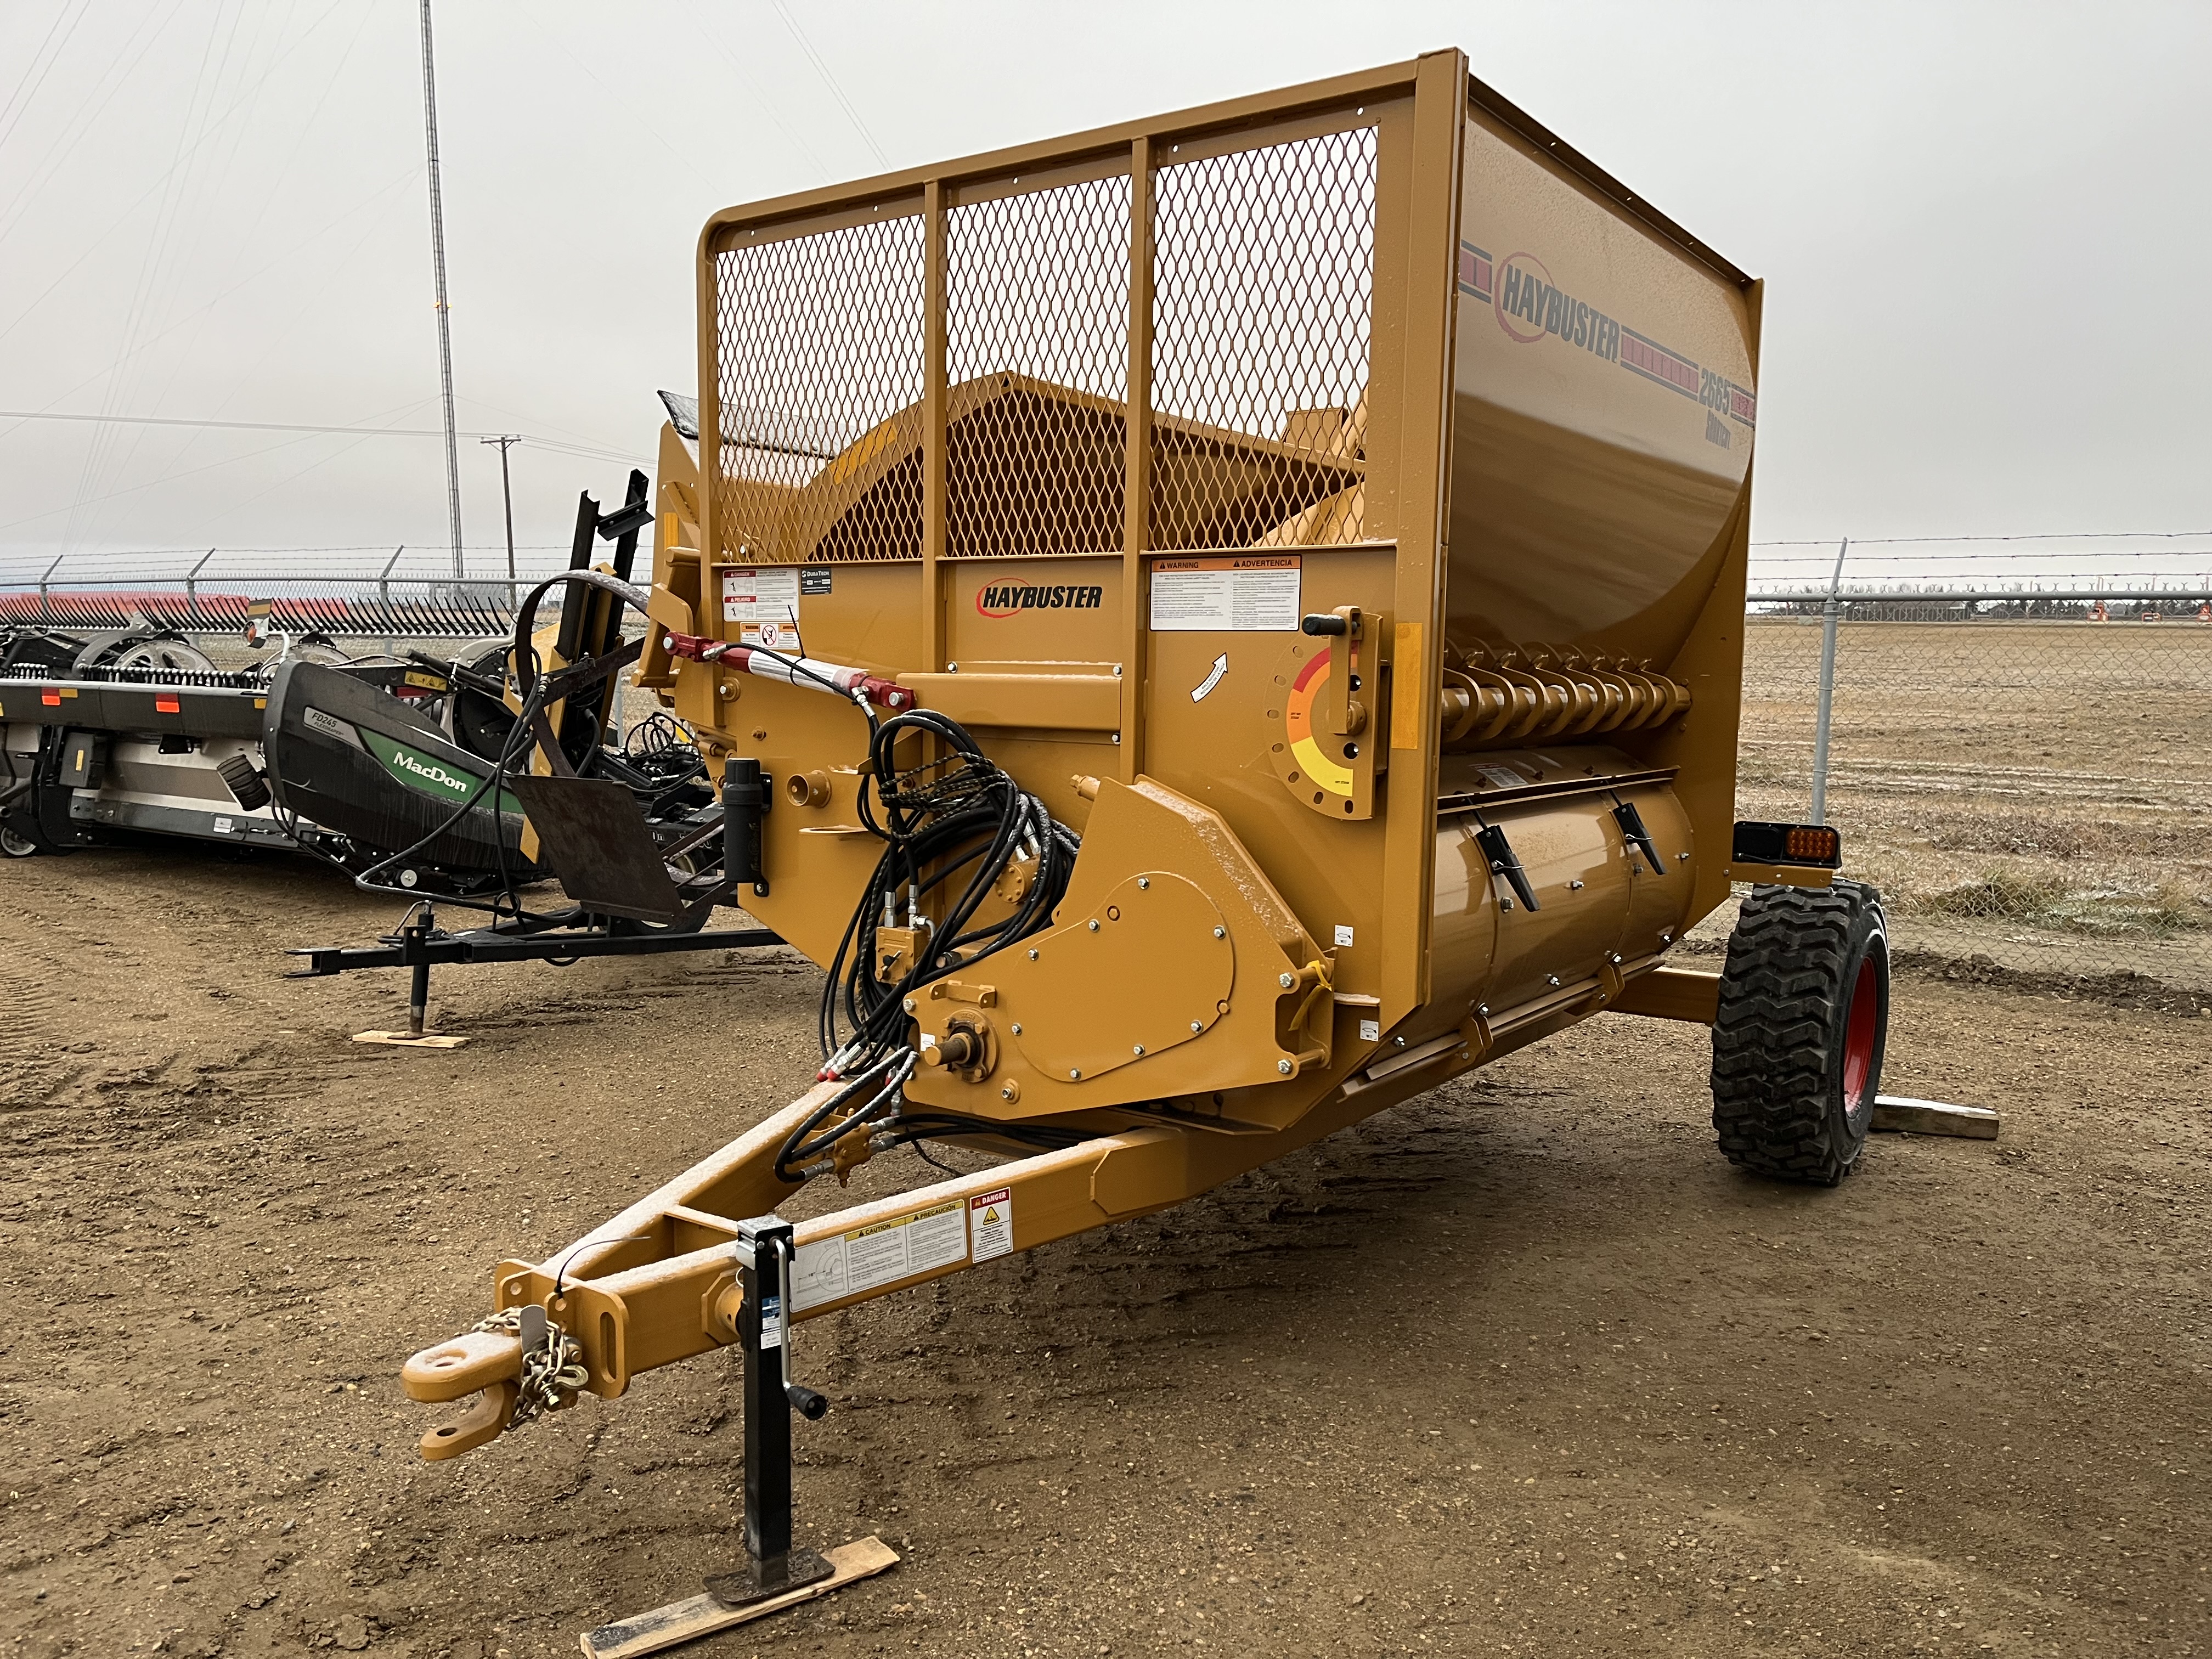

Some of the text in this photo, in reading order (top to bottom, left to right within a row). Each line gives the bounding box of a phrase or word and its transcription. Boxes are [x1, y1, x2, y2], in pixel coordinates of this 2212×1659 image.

[1502, 263, 1620, 363] HAYBUSTER
[1699, 368, 1731, 415] 2665
[1241, 559, 1293, 567] ADVERTENCIA
[983, 585, 1103, 608] HAYBUSTER
[311, 712, 338, 728] FD245
[393, 752, 467, 792] MacDon
[981, 1191, 1007, 1205] DANGER
[919, 1204, 956, 1219] PRECAUCIÓN
[865, 1223, 891, 1235] CAUTION
